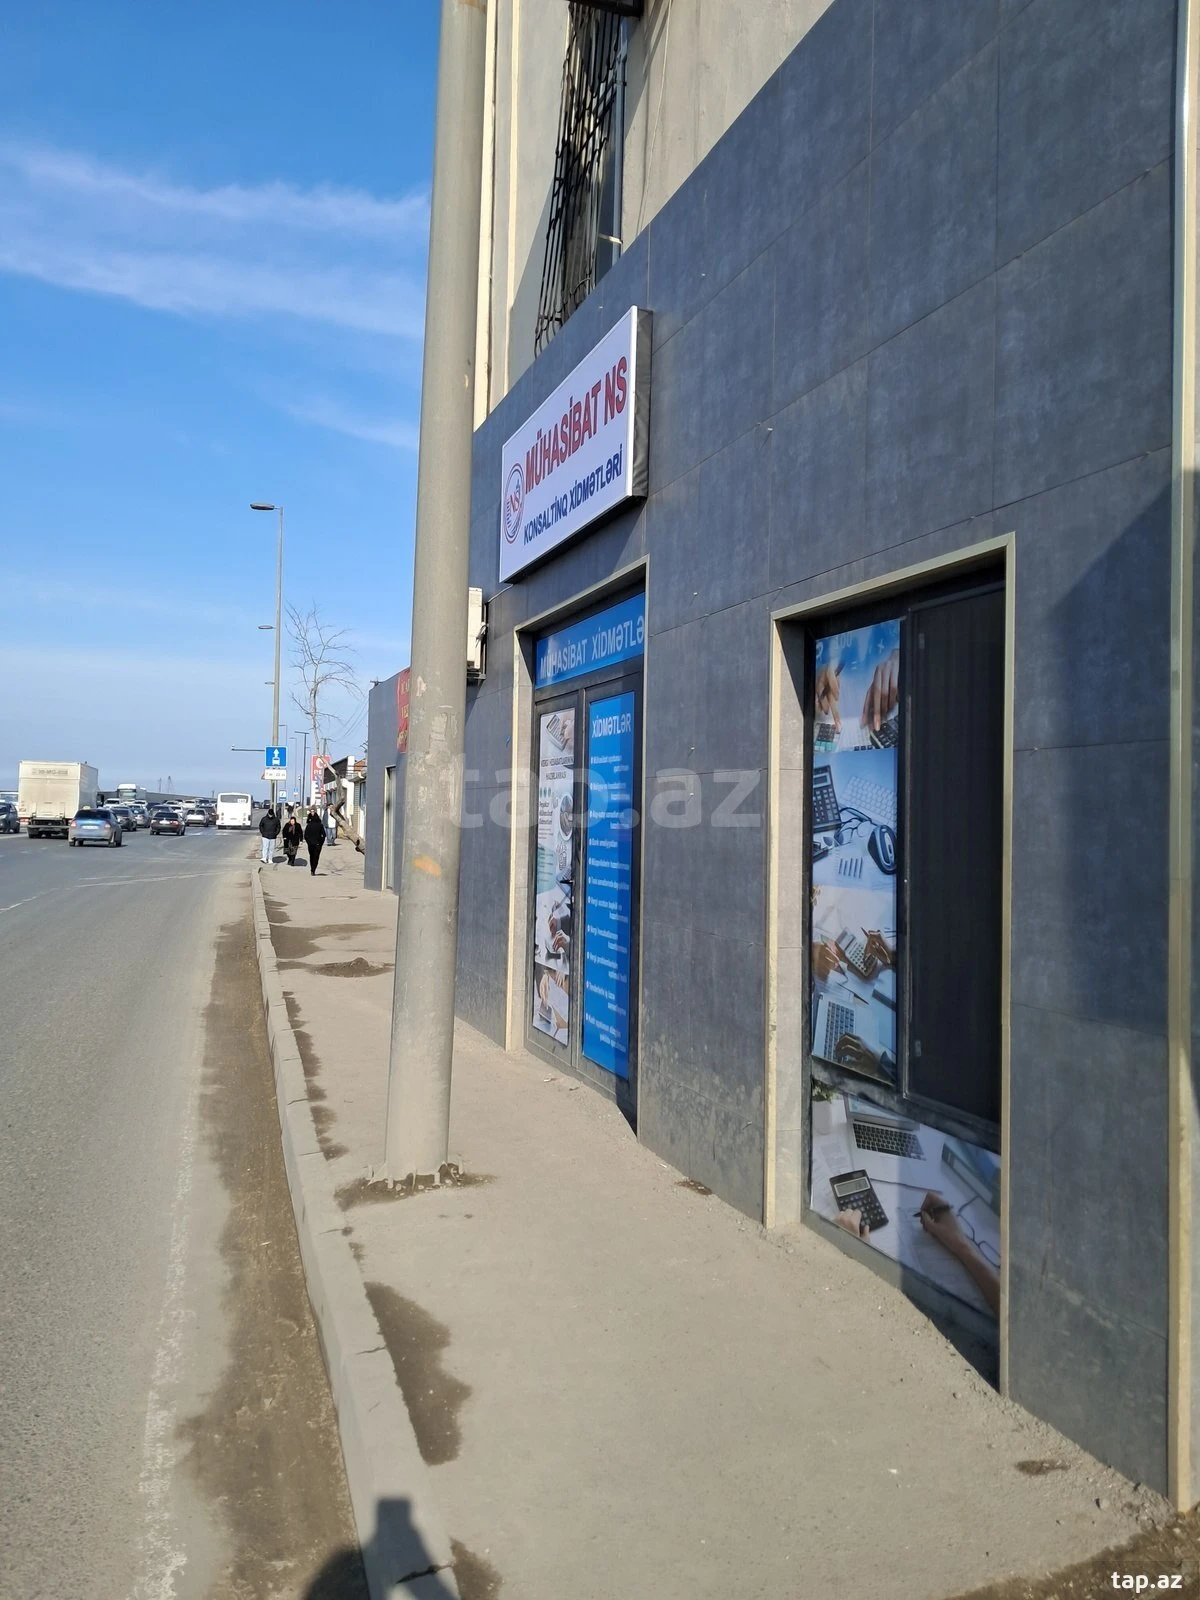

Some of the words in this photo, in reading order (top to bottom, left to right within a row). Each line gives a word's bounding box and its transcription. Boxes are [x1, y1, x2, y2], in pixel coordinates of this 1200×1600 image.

[525, 380, 602, 494] MÜHASİBAT
[603, 356, 628, 427] NS
[523, 494, 569, 546] KONSALTİNQ
[568, 443, 622, 513] XİDMƏTLƏRİ
[592, 712, 632, 738] XİDMƏTLƏR
